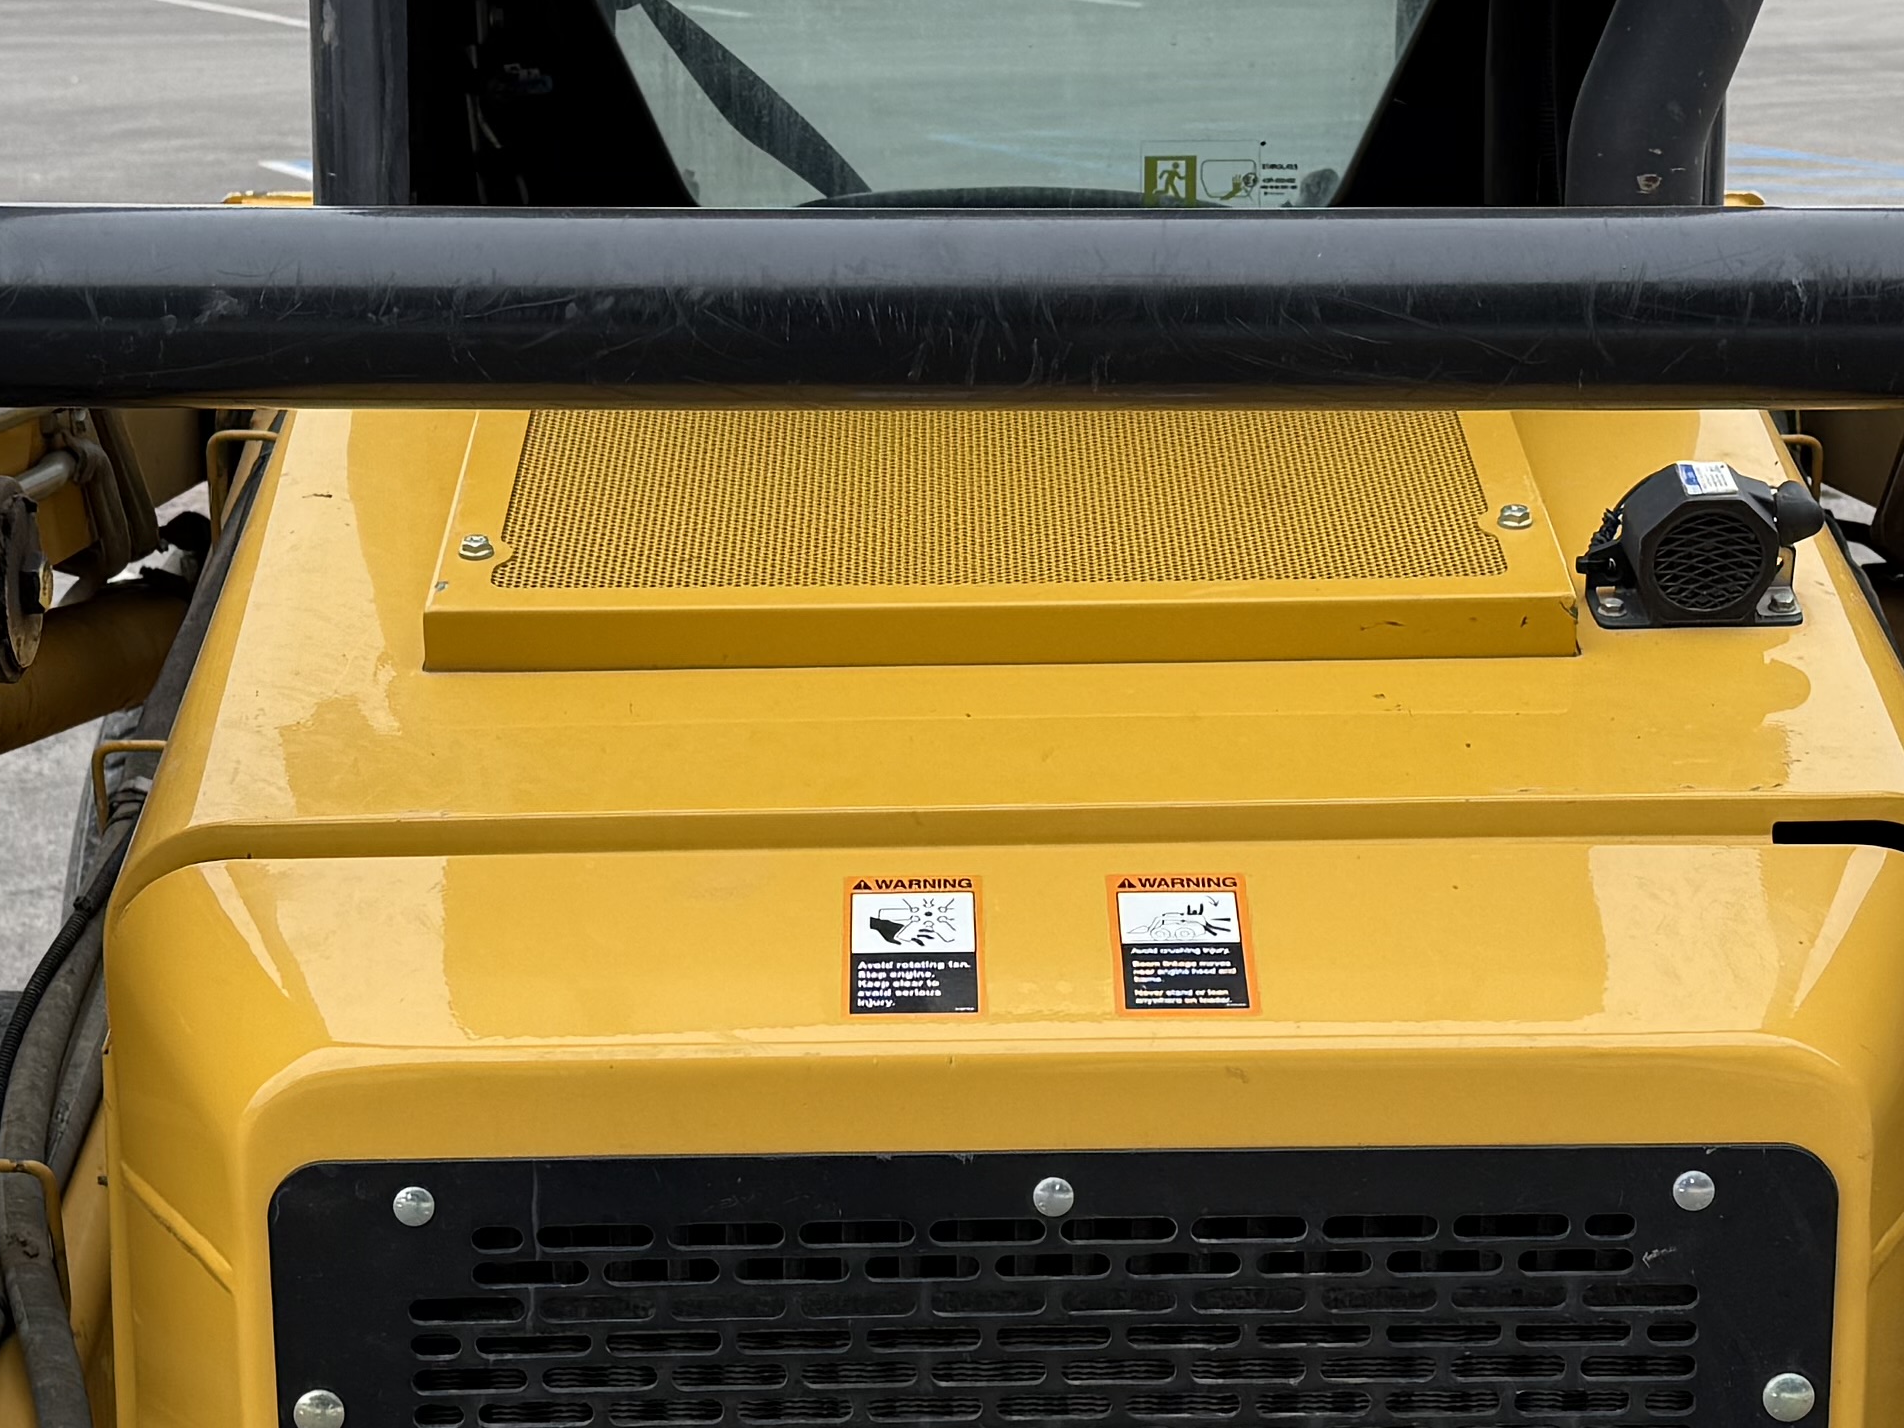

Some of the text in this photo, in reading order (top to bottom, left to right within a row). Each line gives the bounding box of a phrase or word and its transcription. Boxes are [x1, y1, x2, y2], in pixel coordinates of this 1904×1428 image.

[875, 878, 972, 889] WARNING
[1137, 877, 1238, 888] WARNING
[857, 960, 971, 970] Avoid rotating fan.
[857, 970, 935, 980] Stop engine.
[857, 979, 940, 989] Keep clear to
[857, 989, 942, 997] avoid serious
[857, 998, 896, 1008] injury.
